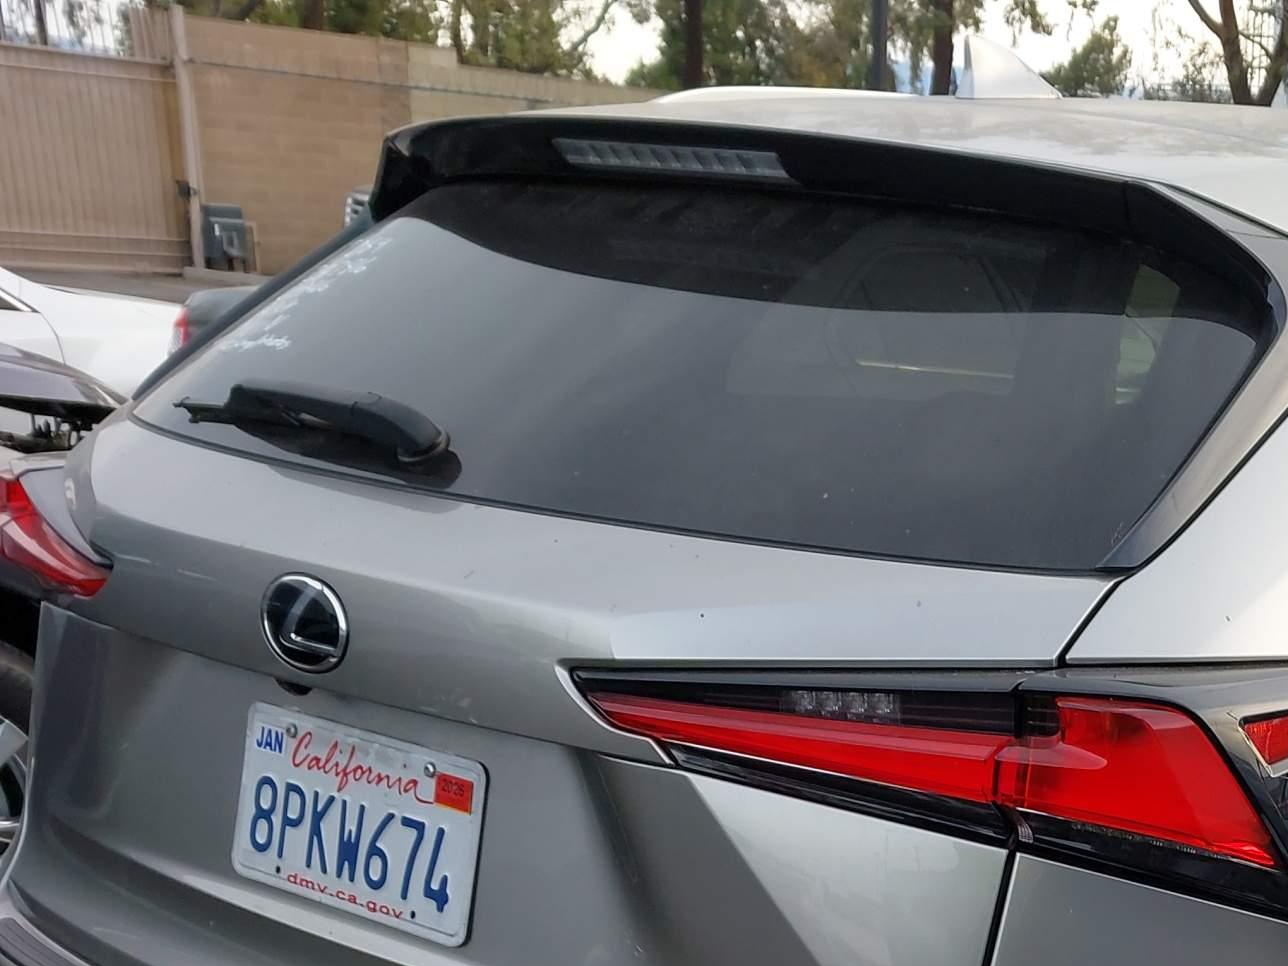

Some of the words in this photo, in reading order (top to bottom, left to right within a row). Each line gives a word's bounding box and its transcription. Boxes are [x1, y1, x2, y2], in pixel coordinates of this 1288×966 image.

[256, 726, 284, 754] JAN
[291, 731, 434, 805] California
[249, 775, 449, 913] 8PKW674
[287, 872, 404, 919] dmv.ca.gov
